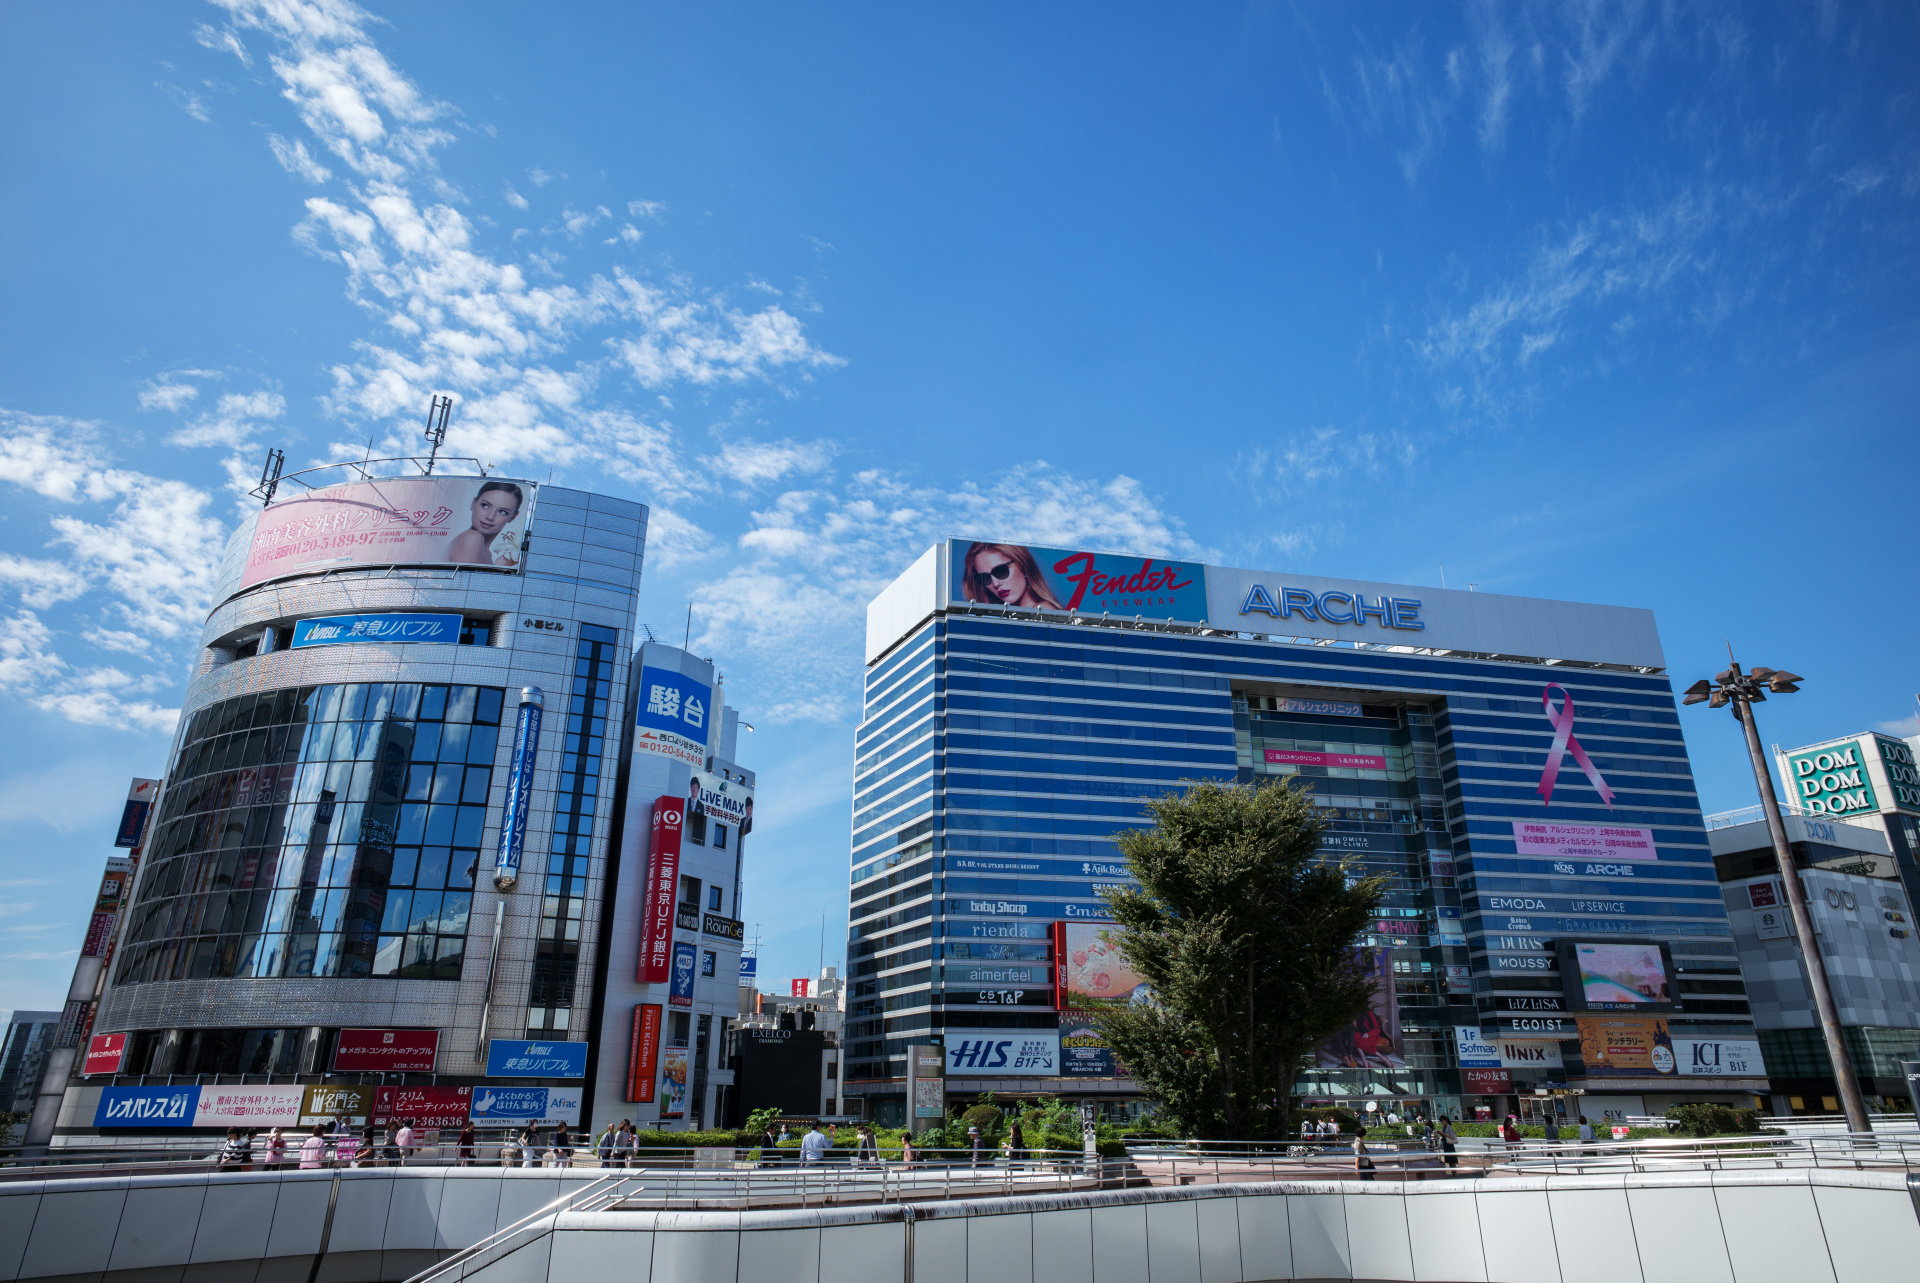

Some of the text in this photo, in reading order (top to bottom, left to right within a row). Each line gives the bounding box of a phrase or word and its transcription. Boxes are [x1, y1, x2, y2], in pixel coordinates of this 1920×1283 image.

[253, 506, 453, 553] 湘南美容外科クリニック
[250, 549, 275, 568] 大宮院
[288, 532, 378, 556] 0120-5489-97
[1053, 552, 1193, 611] Fender
[1102, 597, 1175, 608] EYEWEAR
[1239, 584, 1425, 631] ARCHE
[346, 620, 444, 637] 東急リバブル
[647, 684, 705, 729] 駿台
[1289, 700, 1360, 715] アルシェクリニック
[650, 742, 703, 766] 0120-54-2418
[1881, 742, 1917, 766] DOM
[1793, 748, 1857, 777] DOM
[1799, 768, 1864, 797] DOM
[236, 790, 291, 805] 0120-3
[1804, 789, 1870, 816] DOM
[722, 796, 745, 815] MAX
[125, 803, 142, 836] PROMISE
[508, 774, 530, 868] レオパレス21
[1550, 826, 1596, 835] アルシェクリニック
[1804, 821, 1837, 842] DOM
[1109, 864, 1133, 876] Roug
[1585, 864, 1635, 876] ARCHE
[652, 852, 674, 967] 三菱東京UFJ銀行
[1491, 898, 1546, 910] EMODA
[705, 916, 743, 938] RounGe
[972, 922, 1029, 938] rienda
[1389, 920, 1420, 934] HMV
[1500, 936, 1543, 949] DURAS
[677, 956, 693, 967] MAST
[1498, 958, 1552, 968] MOUSSY
[970, 967, 1031, 982] aimerfeel
[1453, 967, 1463, 975] 5F
[997, 990, 1024, 1004] T&P
[1508, 998, 1560, 1009] LIZ LISA
[1513, 1018, 1562, 1031] EGOIST
[641, 1009, 654, 1068] First Kitchen
[752, 1028, 792, 1039] EXELCO
[1462, 1028, 1475, 1040] 1F
[1607, 1037, 1645, 1045] タッチラリー
[347, 1047, 433, 1055] メガネ・コンタクトのアップル
[1459, 1043, 1497, 1055] Sofmap
[1504, 1044, 1546, 1061] UNIX
[1692, 1042, 1723, 1066] ICI
[502, 1058, 571, 1071] 東急リバブル
[1014, 1057, 1041, 1068] B1F
[1729, 1061, 1747, 1072] B1F
[1467, 1071, 1509, 1081] たかの友梨
[398, 1091, 425, 1102] スリム
[457, 1086, 471, 1095] 6F
[497, 1092, 535, 1100] よくわかる!
[106, 1094, 189, 1118] レオパレス21
[198, 1102, 215, 1111] SBC
[217, 1095, 300, 1105] 湘南美容外科クリニック
[324, 1092, 361, 1109] 名門会
[395, 1101, 468, 1112] ビューティハウス
[496, 1100, 539, 1110] ほけん案内
[550, 1098, 577, 1109] Aflac
[214, 1106, 298, 1116] 大宮院 0120-5489-97
